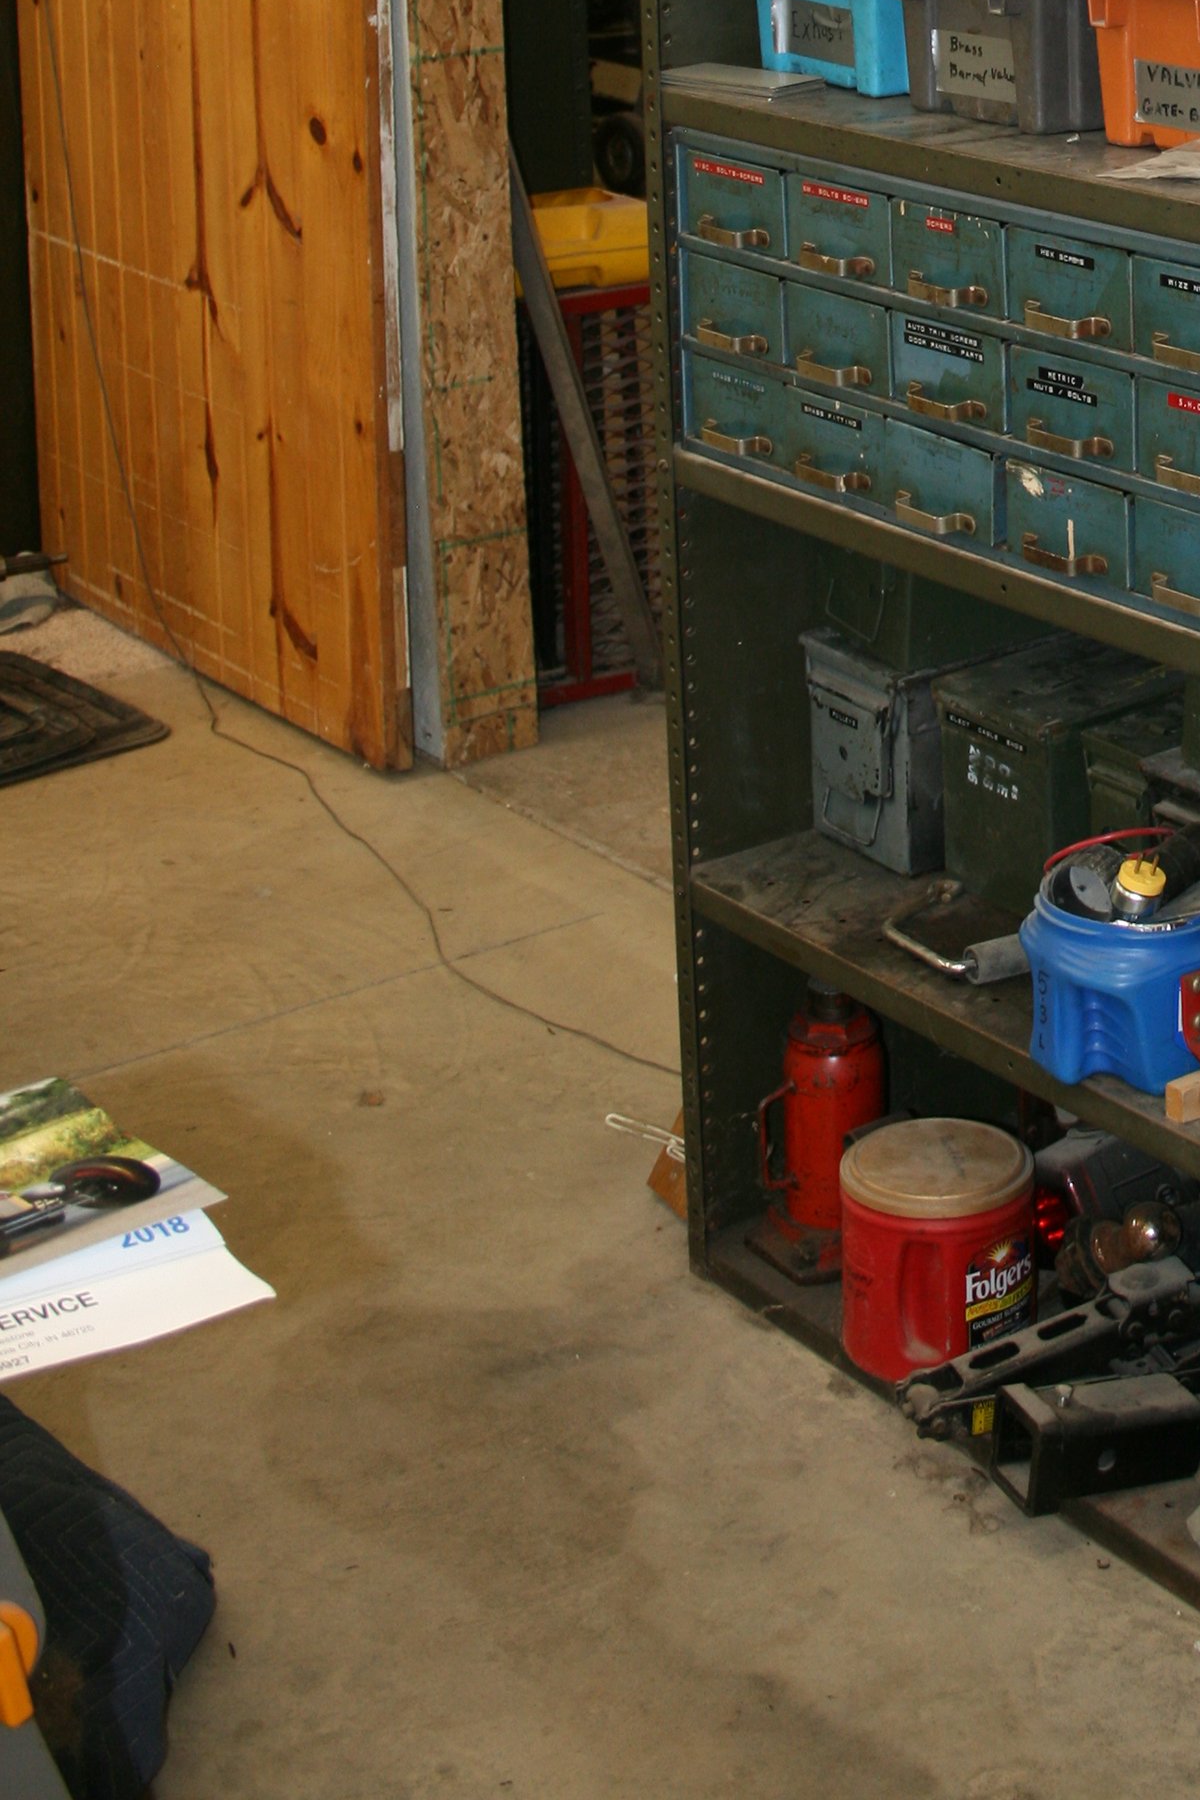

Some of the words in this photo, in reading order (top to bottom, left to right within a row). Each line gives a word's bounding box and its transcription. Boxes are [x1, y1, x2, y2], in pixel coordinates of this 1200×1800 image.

[949, 36, 983, 57] Brass
[907, 321, 927, 334] AUTO
[908, 335, 928, 348] DOOR
[960, 348, 985, 361] PARTS
[1047, 370, 1077, 387] METRIC
[1033, 382, 1055, 396] NUTS
[1066, 388, 1093, 405] BOLTS
[831, 710, 857, 728] PULLEYS
[949, 714, 971, 729] ELECT
[977, 726, 999, 742] CABLE
[121, 1215, 190, 1250] 2018
[966, 1253, 1033, 1304] Folgers
[972, 1311, 1003, 1331] GOURMET
